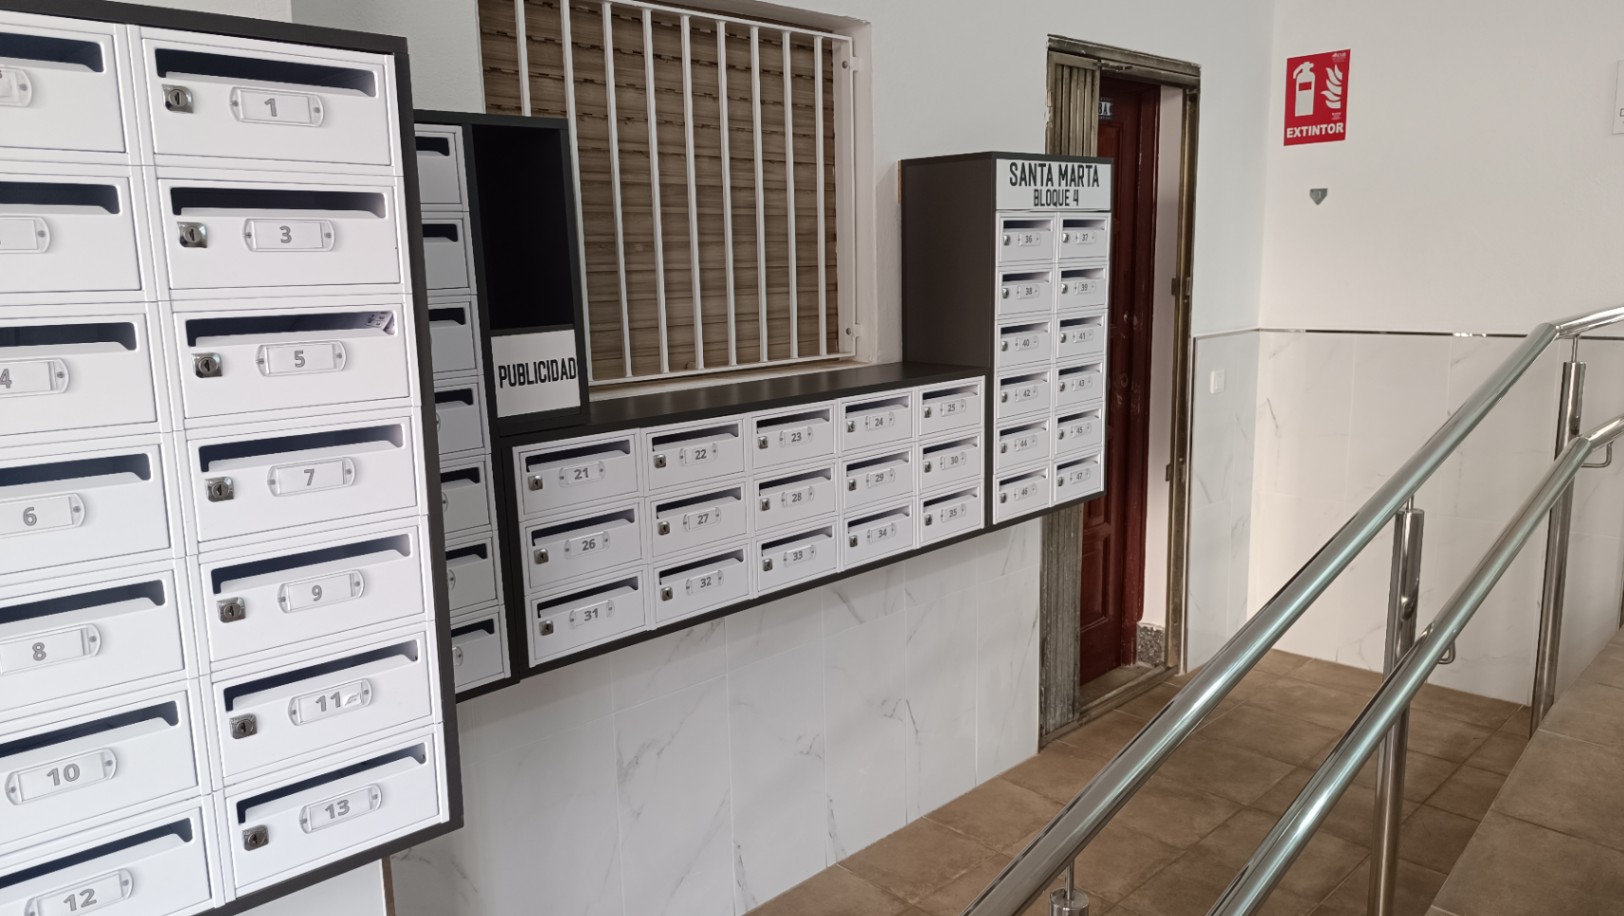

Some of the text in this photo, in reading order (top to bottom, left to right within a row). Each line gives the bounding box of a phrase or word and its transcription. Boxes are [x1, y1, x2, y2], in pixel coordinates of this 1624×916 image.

[264, 98, 278, 117] 1
[1286, 122, 1344, 139] EXTINTOR
[1010, 162, 1099, 187] SANTA MARTA
[1034, 189, 1079, 207] BLOQUE 4
[280, 225, 292, 243] 3
[1082, 234, 1088, 242] 37
[294, 351, 305, 367] 5
[498, 356, 576, 388] PUBLICIDAD
[875, 418, 884, 426] 24
[792, 432, 801, 442] 23
[695, 449, 706, 459] 22
[950, 456, 958, 464] 30
[304, 470, 315, 486] 7
[574, 468, 588, 479] 21
[876, 473, 884, 482] 29
[792, 492, 802, 502] 28
[23, 507, 37, 525] 6
[697, 514, 709, 524] 27
[949, 509, 957, 517] 35
[878, 528, 887, 538] 34
[582, 539, 595, 550] 26
[793, 551, 803, 560] 33
[700, 577, 711, 587] 32
[311, 586, 322, 601] 9
[584, 609, 598, 620] 31
[32, 643, 46, 661] 8
[315, 692, 342, 712] 11
[46, 763, 79, 786] 10
[325, 799, 350, 817] 13
[64, 889, 94, 910] 12
